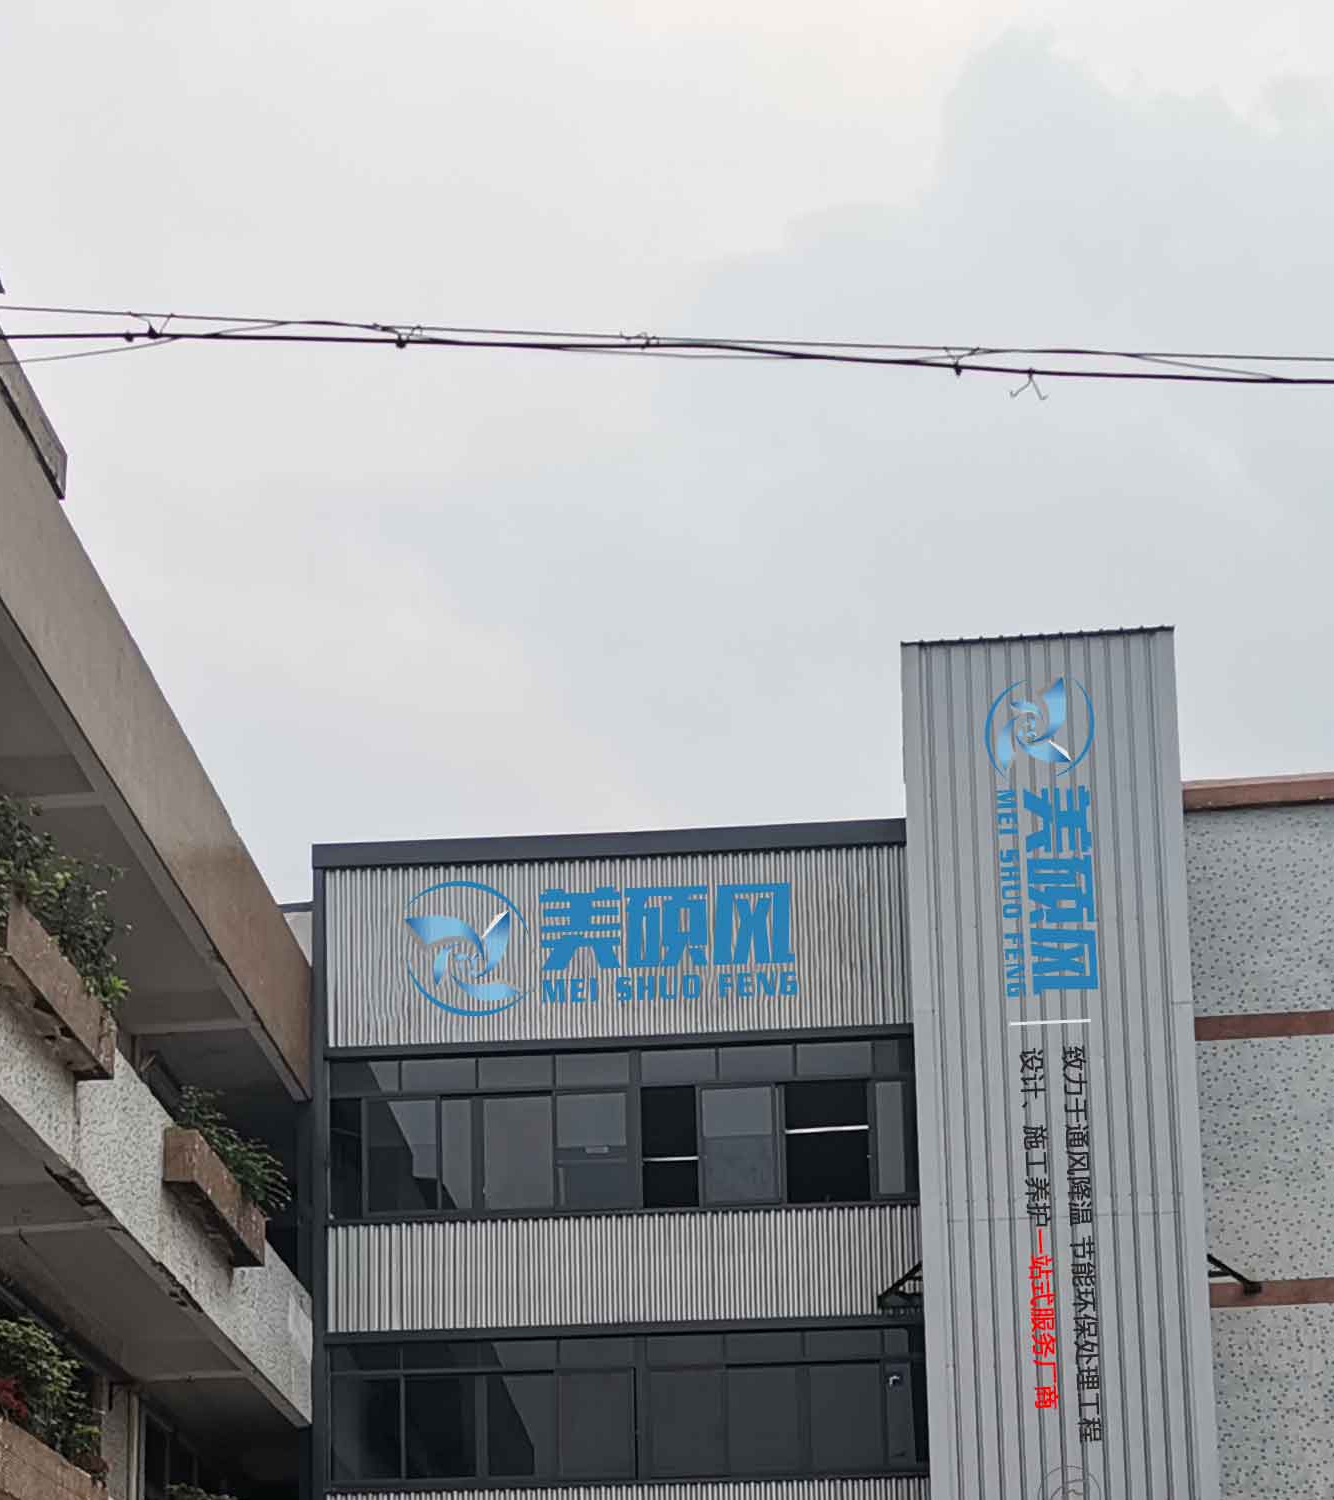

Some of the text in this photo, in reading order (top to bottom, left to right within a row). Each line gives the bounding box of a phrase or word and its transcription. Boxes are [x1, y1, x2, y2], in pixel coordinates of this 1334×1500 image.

[538, 882, 795, 971] 美硕风
[994, 789, 1027, 998] MEI SHUO FENG
[1023, 784, 1099, 995] 美硕风
[541, 970, 799, 1004] MEI SHUO FENG
